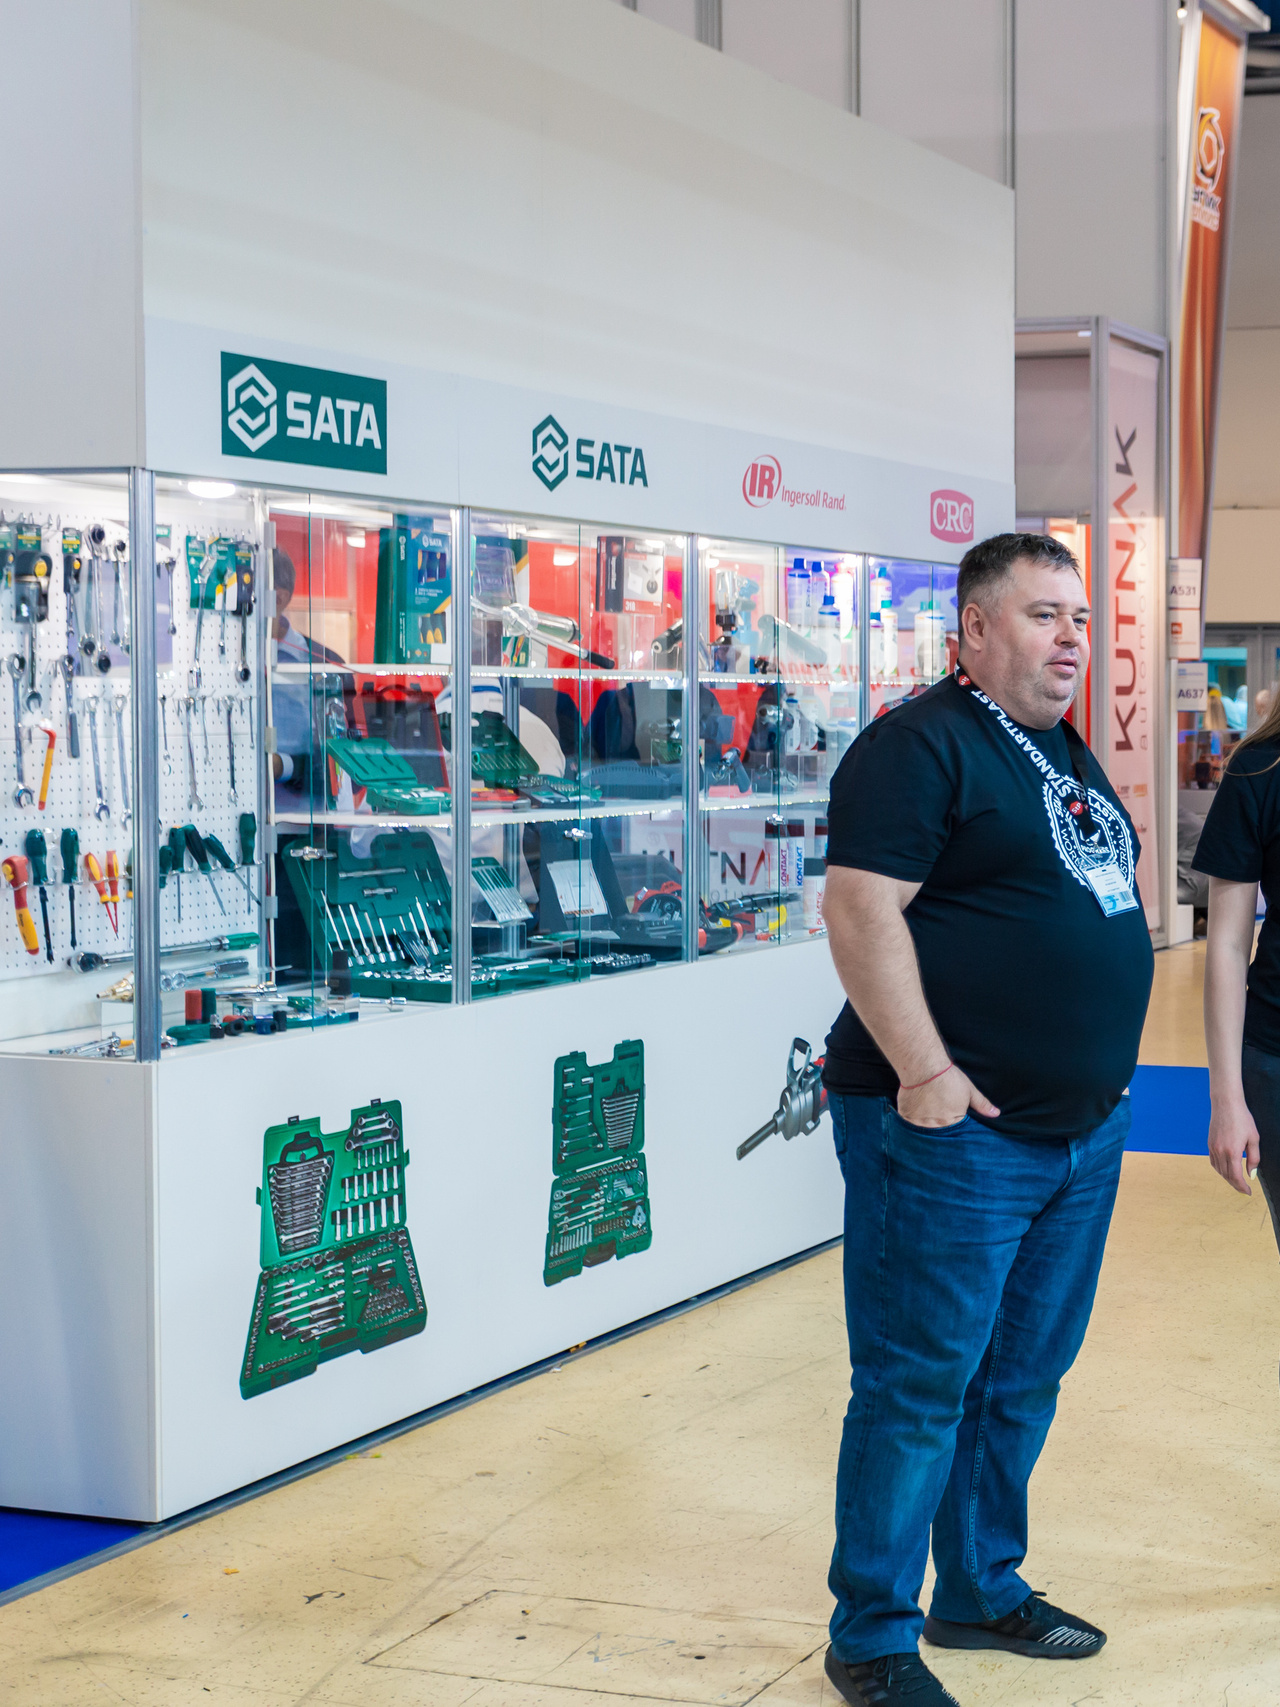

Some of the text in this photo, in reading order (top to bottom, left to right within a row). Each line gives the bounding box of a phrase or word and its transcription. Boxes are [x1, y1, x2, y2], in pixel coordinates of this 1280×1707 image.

[286, 390, 382, 450] SATA
[575, 438, 649, 488] SATA
[748, 463, 776, 500] IR
[781, 485, 821, 508] Ingersoll
[932, 497, 973, 534] CRC
[1177, 689, 1204, 699] A637
[970, 690, 1072, 798] STANDARTPLAST
